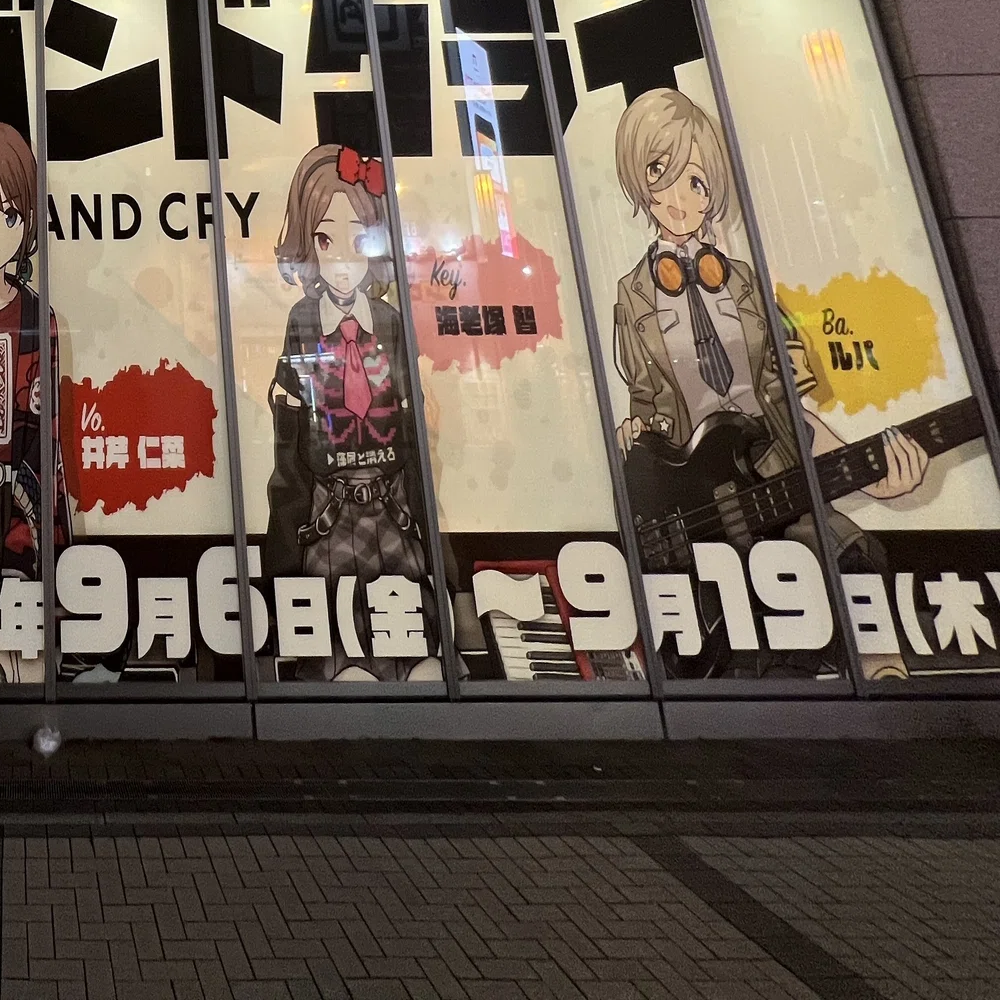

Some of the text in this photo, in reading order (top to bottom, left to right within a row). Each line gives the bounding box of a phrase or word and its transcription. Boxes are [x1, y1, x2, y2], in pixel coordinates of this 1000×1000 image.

[430, 259, 466, 300] Key.
[822, 308, 853, 335] Ba.
[827, 340, 880, 371] ルパ
[81, 402, 105, 432] Vo.
